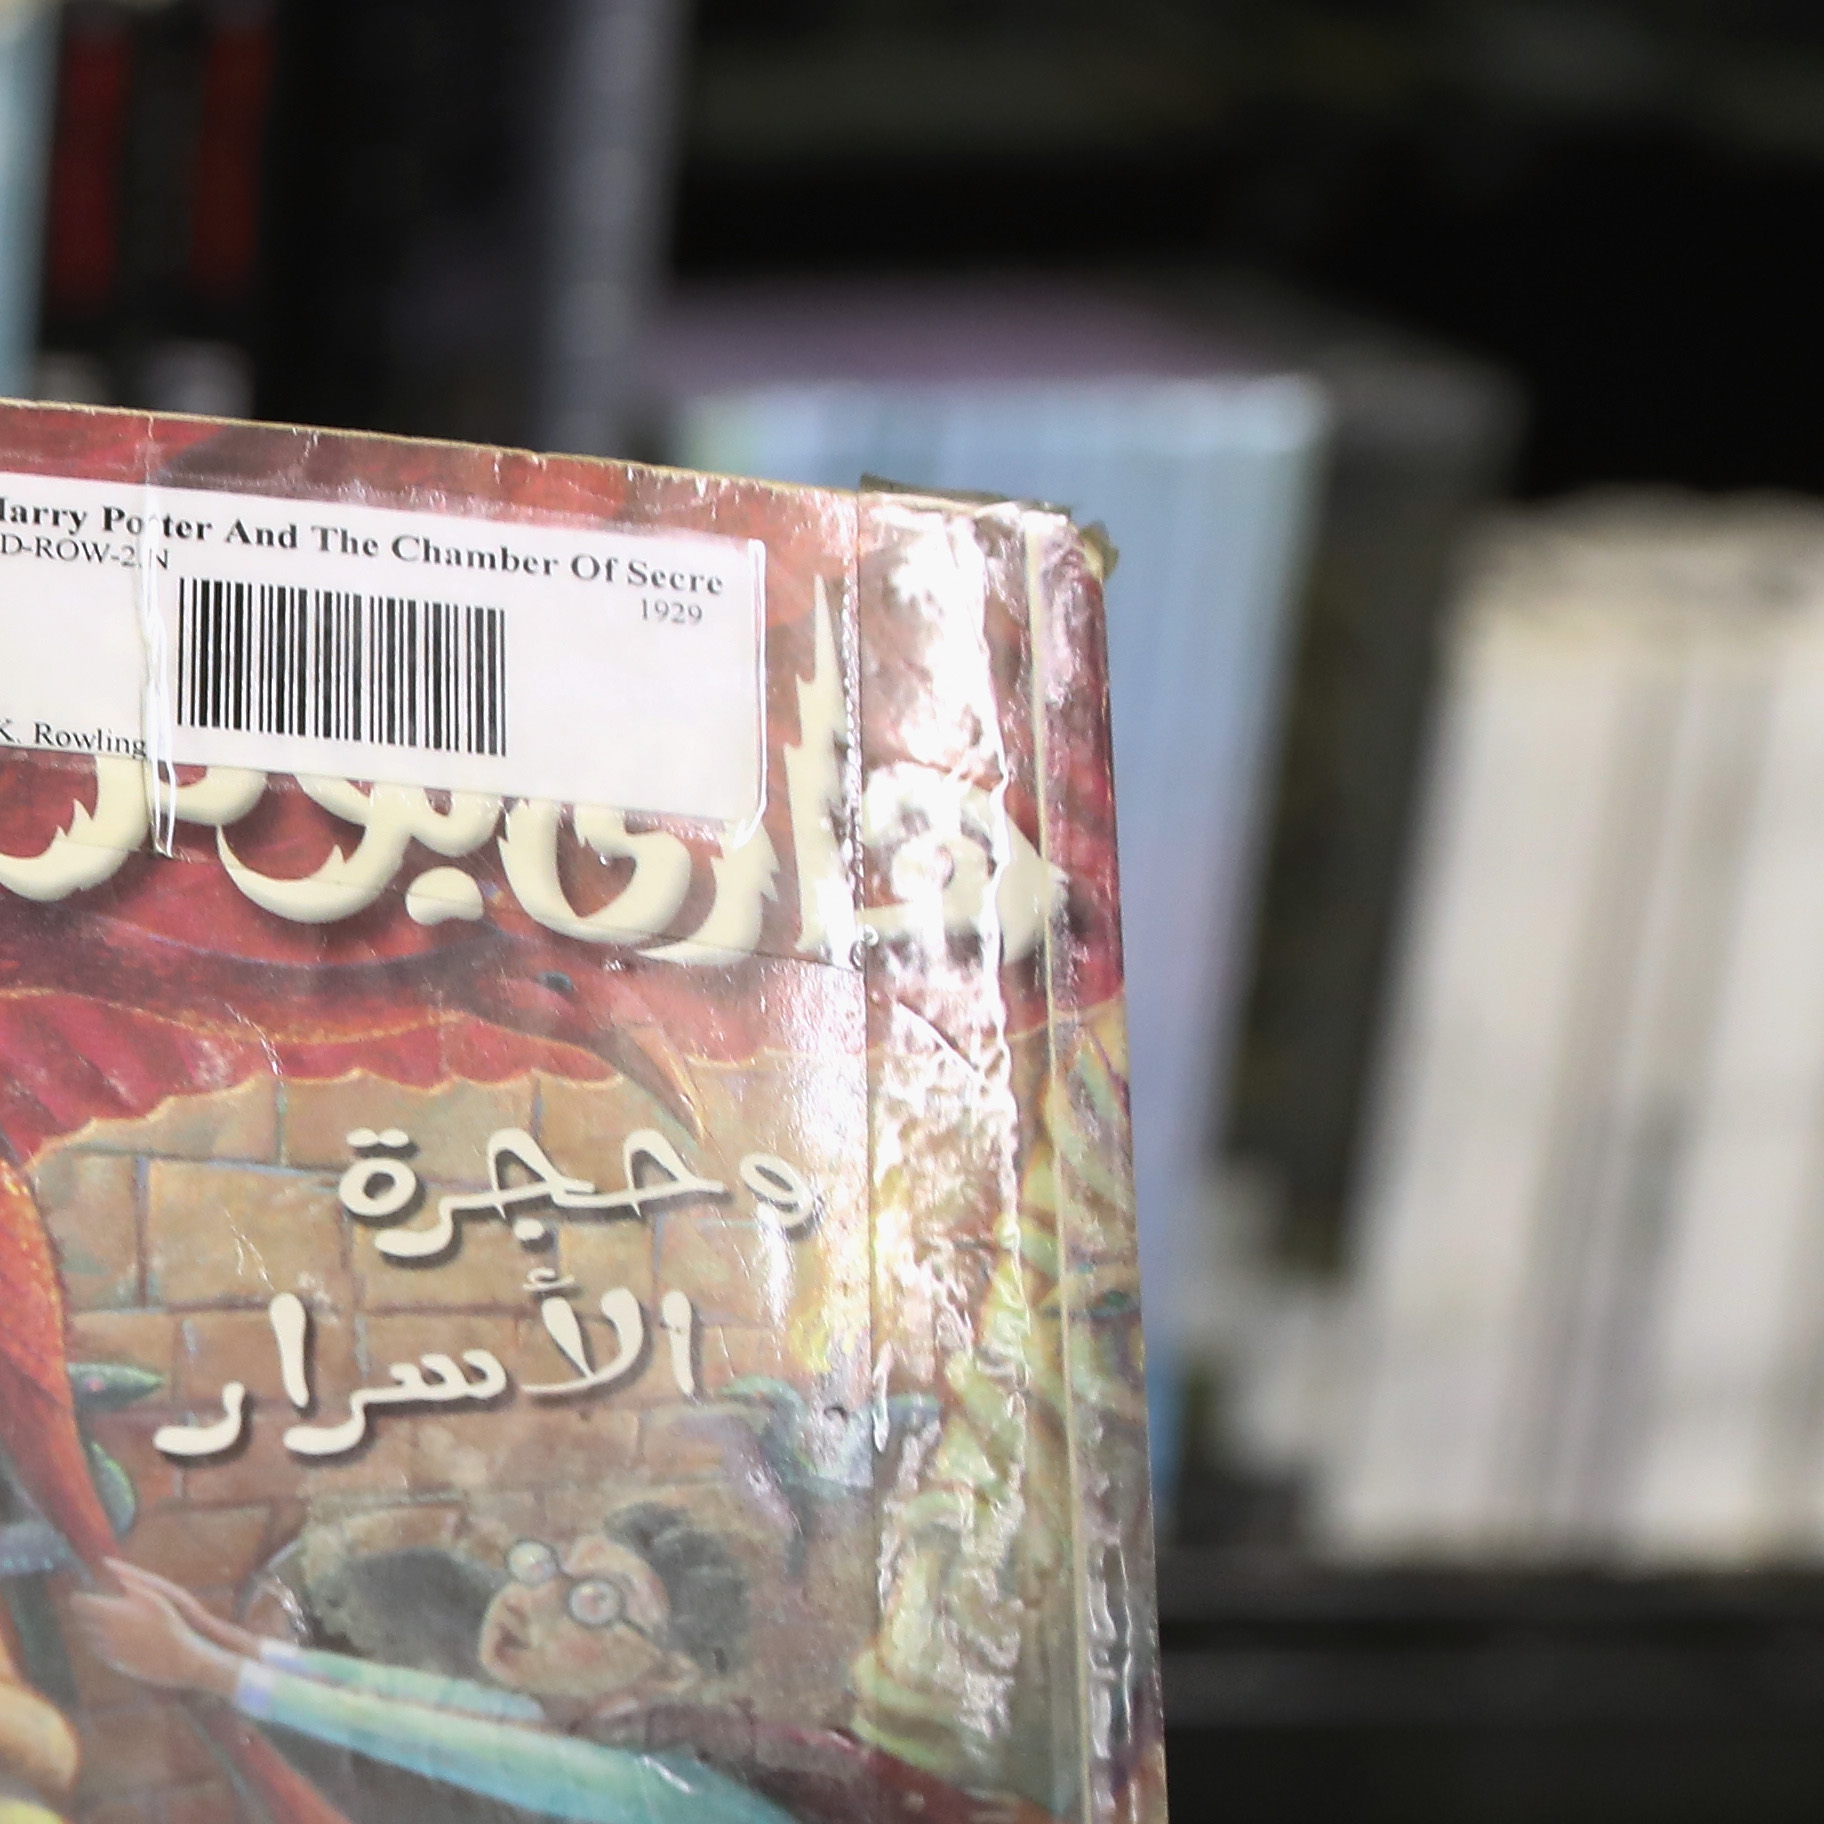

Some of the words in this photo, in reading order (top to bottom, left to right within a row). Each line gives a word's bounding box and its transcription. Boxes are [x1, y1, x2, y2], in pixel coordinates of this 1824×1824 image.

[101, 505, 213, 541] Poter
[225, 519, 298, 549] And
[309, 524, 380, 558] The
[390, 533, 559, 578] Chamber
[570, 553, 619, 582] Of
[626, 559, 726, 596] Secre
[638, 597, 705, 625] 1929
[34, 721, 148, 757] Rowling
[152, 1267, 694, 1459] الأسرار
